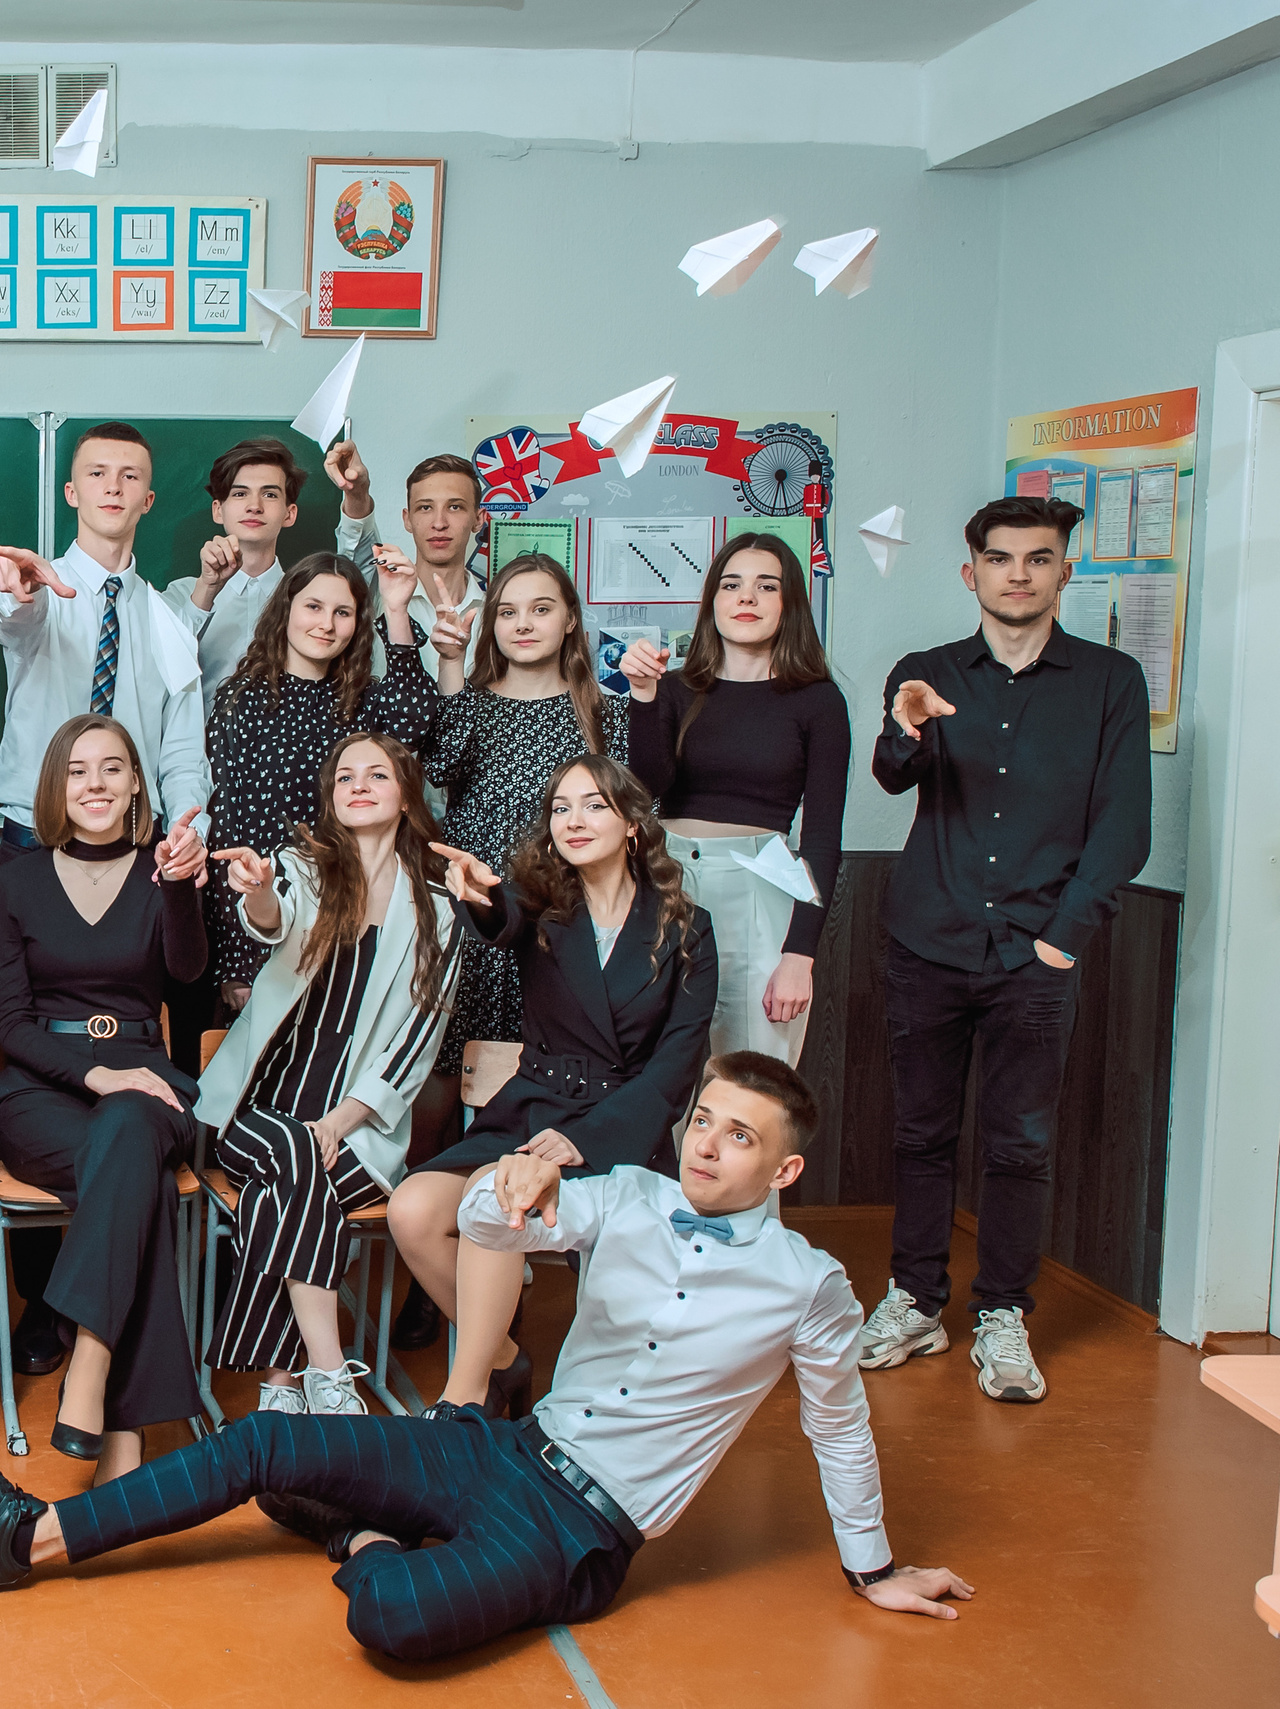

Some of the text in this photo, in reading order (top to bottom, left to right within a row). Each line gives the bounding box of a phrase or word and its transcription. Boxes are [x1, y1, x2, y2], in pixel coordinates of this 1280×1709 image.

[54, 218, 77, 239] Kk
[135, 244, 153, 254] /el/
[207, 246, 230, 255] /em/
[55, 282, 79, 302] Xx
[131, 282, 156, 308] Yy
[204, 284, 230, 304] Zz
[56, 307, 81, 317] /eks/
[205, 309, 230, 319] /zed/
[1033, 404, 1163, 446] INFORMATION
[659, 465, 699, 476] LONDON
